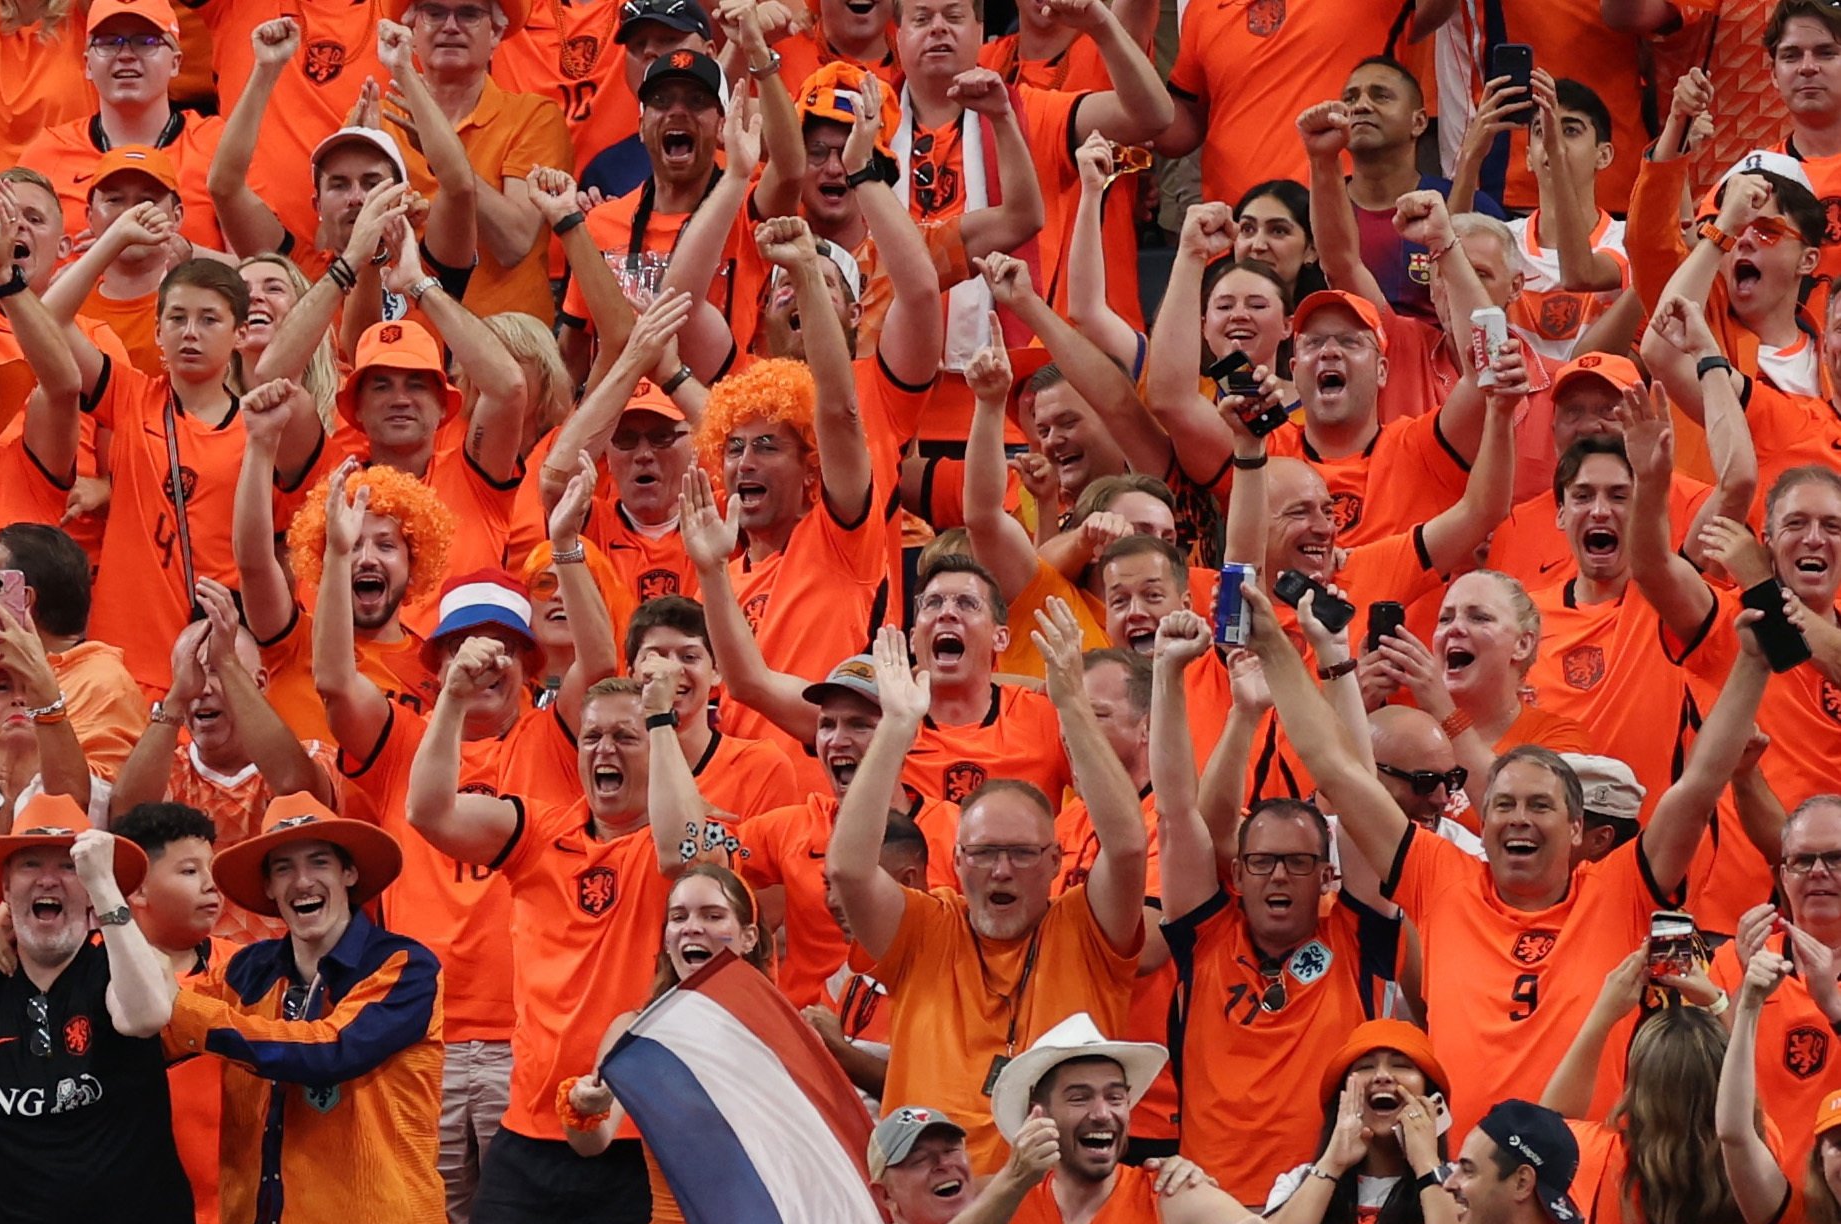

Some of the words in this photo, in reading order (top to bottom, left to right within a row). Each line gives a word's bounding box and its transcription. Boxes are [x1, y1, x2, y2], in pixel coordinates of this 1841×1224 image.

[1471, 327, 1490, 370] STELLA
[155, 512, 176, 569] 4
[1509, 974, 1539, 1022] 9
[1519, 1142, 1546, 1167] viaplay
